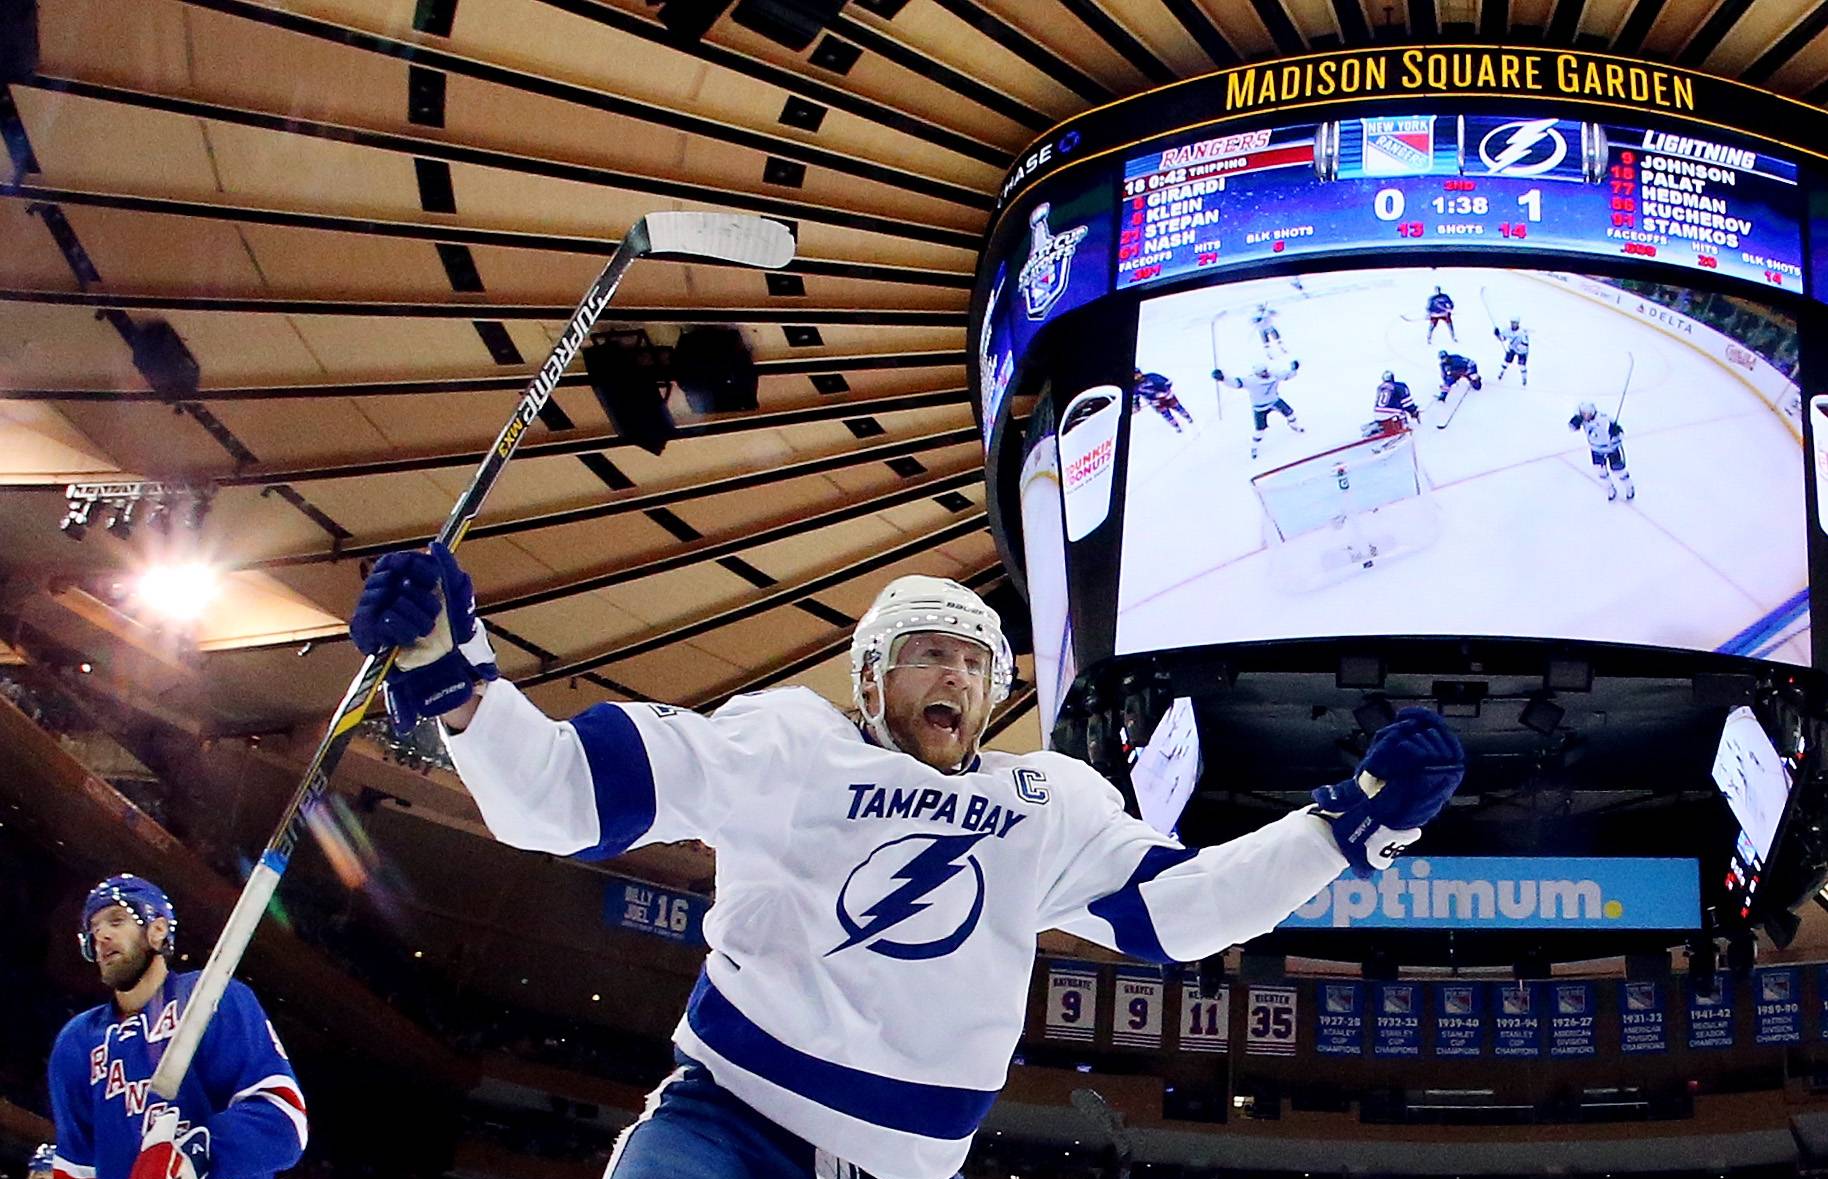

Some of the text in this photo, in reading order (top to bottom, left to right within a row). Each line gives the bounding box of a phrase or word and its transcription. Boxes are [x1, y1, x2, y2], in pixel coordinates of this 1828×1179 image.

[1226, 49, 1695, 111] MADISON SQUARE GARDEN
[1367, 119, 1428, 132] NEW YORK
[1160, 129, 1273, 170] RANGERS
[1641, 129, 1757, 170] LIGHTNING
[1124, 157, 1248, 196] 18 0:42 TRIPPING
[1641, 155, 1736, 186] JOHNSON
[1641, 169, 1706, 194] PALAT
[1147, 177, 1225, 208] GIRARDI
[1374, 188, 1406, 222] 0
[1432, 196, 1488, 215] 1:38
[1518, 188, 1543, 223] 1
[1610, 180, 1727, 214] 77 HEDMAN
[1144, 209, 1219, 239] STEPAN
[1146, 198, 1203, 223] KLEIN
[1642, 201, 1752, 236] KUCHEROV
[1144, 230, 1196, 254] NASH
[1246, 225, 1314, 244] BLK SHOTS
[1397, 222, 1424, 238] 13
[1437, 224, 1484, 234] SHOTS
[1499, 222, 1527, 239] 14
[1607, 228, 1668, 246] FACEOFFS
[1643, 218, 1739, 248] STAMKOS
[1118, 250, 1173, 273] FACEOFFS
[1194, 240, 1221, 254] HITS
[1692, 241, 1719, 255] HITS
[1742, 252, 1801, 276] BLK SHOTS
[516, 284, 607, 426] SUPREME
[1012, 766, 1050, 805] C
[847, 783, 1027, 839] TAMPA BAY
[654, 895, 689, 932] 16
[148, 1000, 180, 1043] A
[1061, 990, 1082, 1024] 9
[1128, 997, 1150, 1030] 9
[1189, 1002, 1219, 1036] 11
[1251, 1005, 1293, 1039] 35
